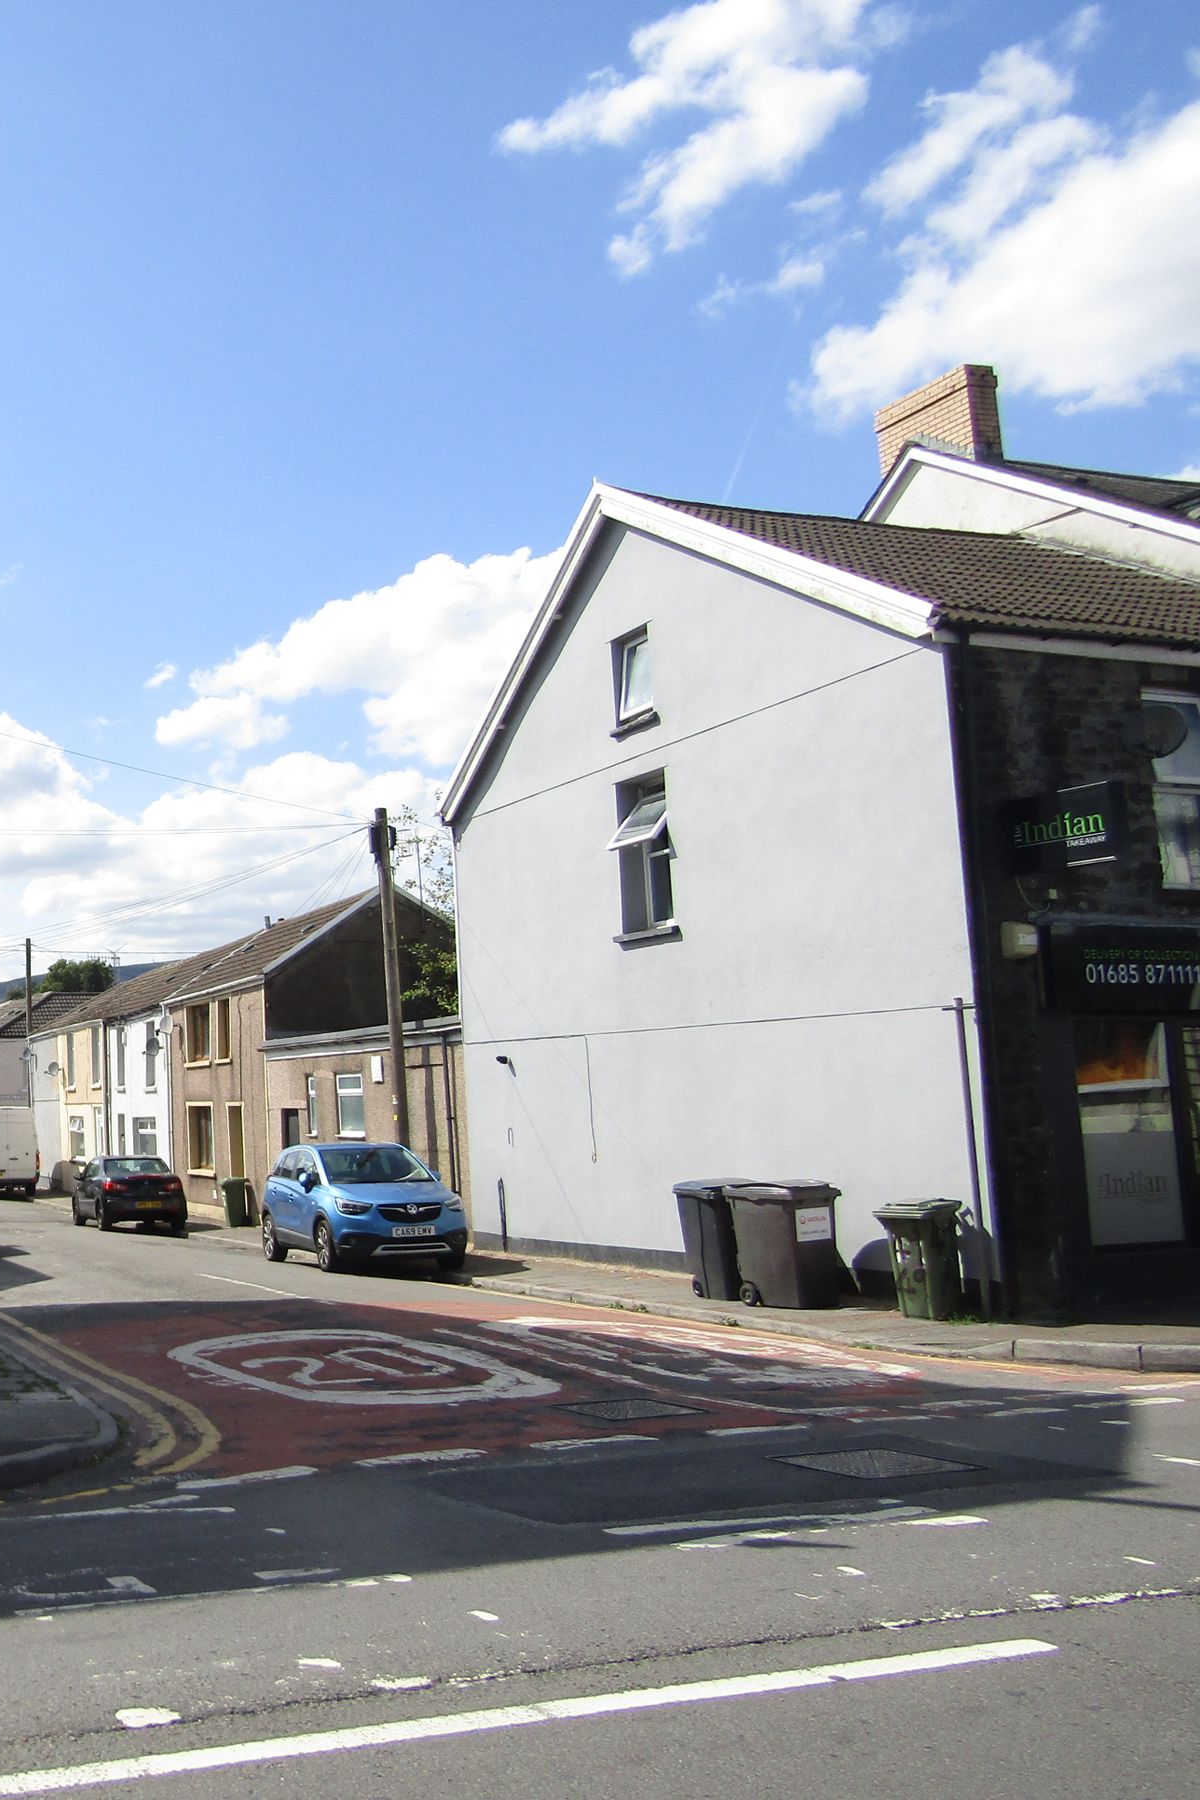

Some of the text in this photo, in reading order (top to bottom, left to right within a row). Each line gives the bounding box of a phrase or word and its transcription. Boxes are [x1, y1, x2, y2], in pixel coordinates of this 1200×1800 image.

[1023, 811, 1105, 844] Indian
[1065, 834, 1106, 847] TAKEAWAY
[1085, 963, 1139, 984] 01685
[395, 1226, 432, 1236] CA69 EMV
[240, 1346, 456, 1386] 20
